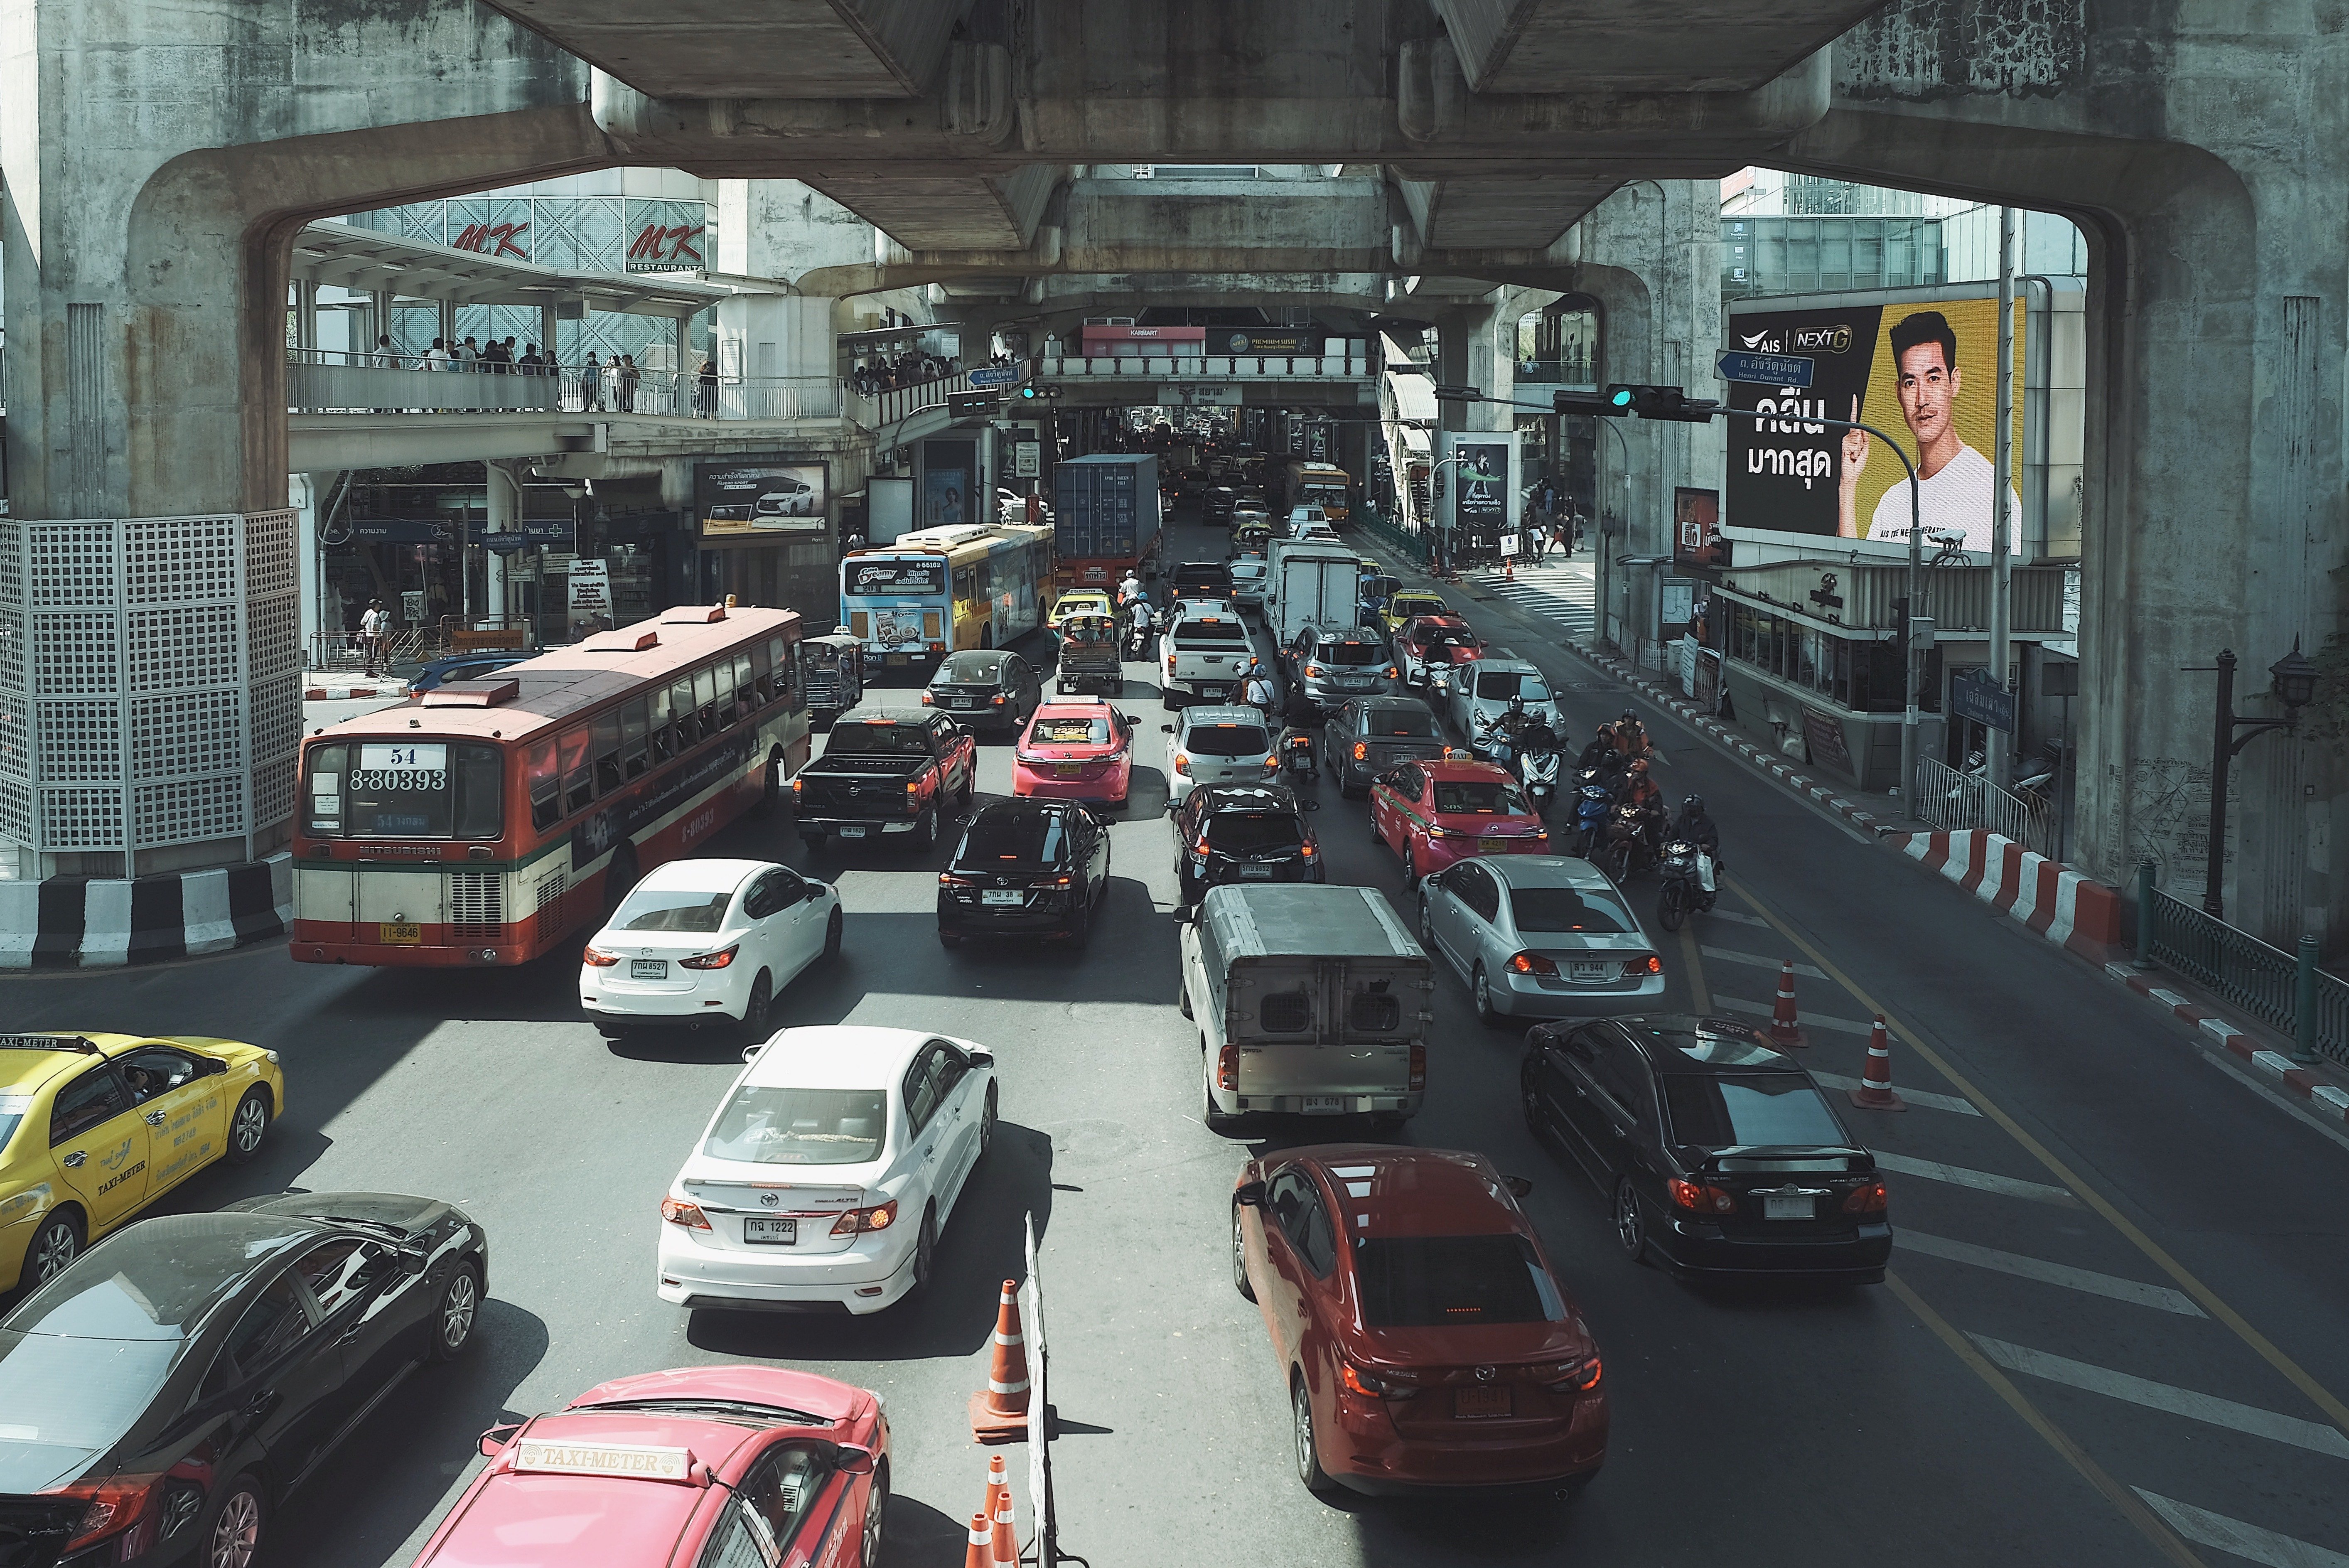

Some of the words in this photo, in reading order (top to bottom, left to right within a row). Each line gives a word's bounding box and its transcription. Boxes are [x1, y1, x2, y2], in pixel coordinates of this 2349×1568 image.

[452, 221, 529, 260] MK
[628, 223, 705, 261] MK
[629, 263, 705, 271] RESTAURANTS
[1761, 339, 1780, 353] AIS
[1738, 371, 1757, 381] Henri
[1760, 374, 1784, 383] Dunant
[1787, 376, 1799, 384] Rd.
[1199, 385, 1222, 396] สยาม
[1748, 447, 1831, 490] มากสุด
[391, 748, 416, 764] 54
[350, 769, 446, 791] 8-80393
[377, 815, 392, 828] 54
[682, 808, 715, 843] 8-80393
[359, 846, 440, 855] MITSUBISHI
[383, 926, 418, 938] 11-9646
[649, 962, 665, 971] 8527
[1325, 1097, 1339, 1106] 678
[98, 1160, 146, 1197] TAXI-METER
[770, 1222, 794, 1233] 1222
[543, 1447, 658, 1473] TAXI-METER
